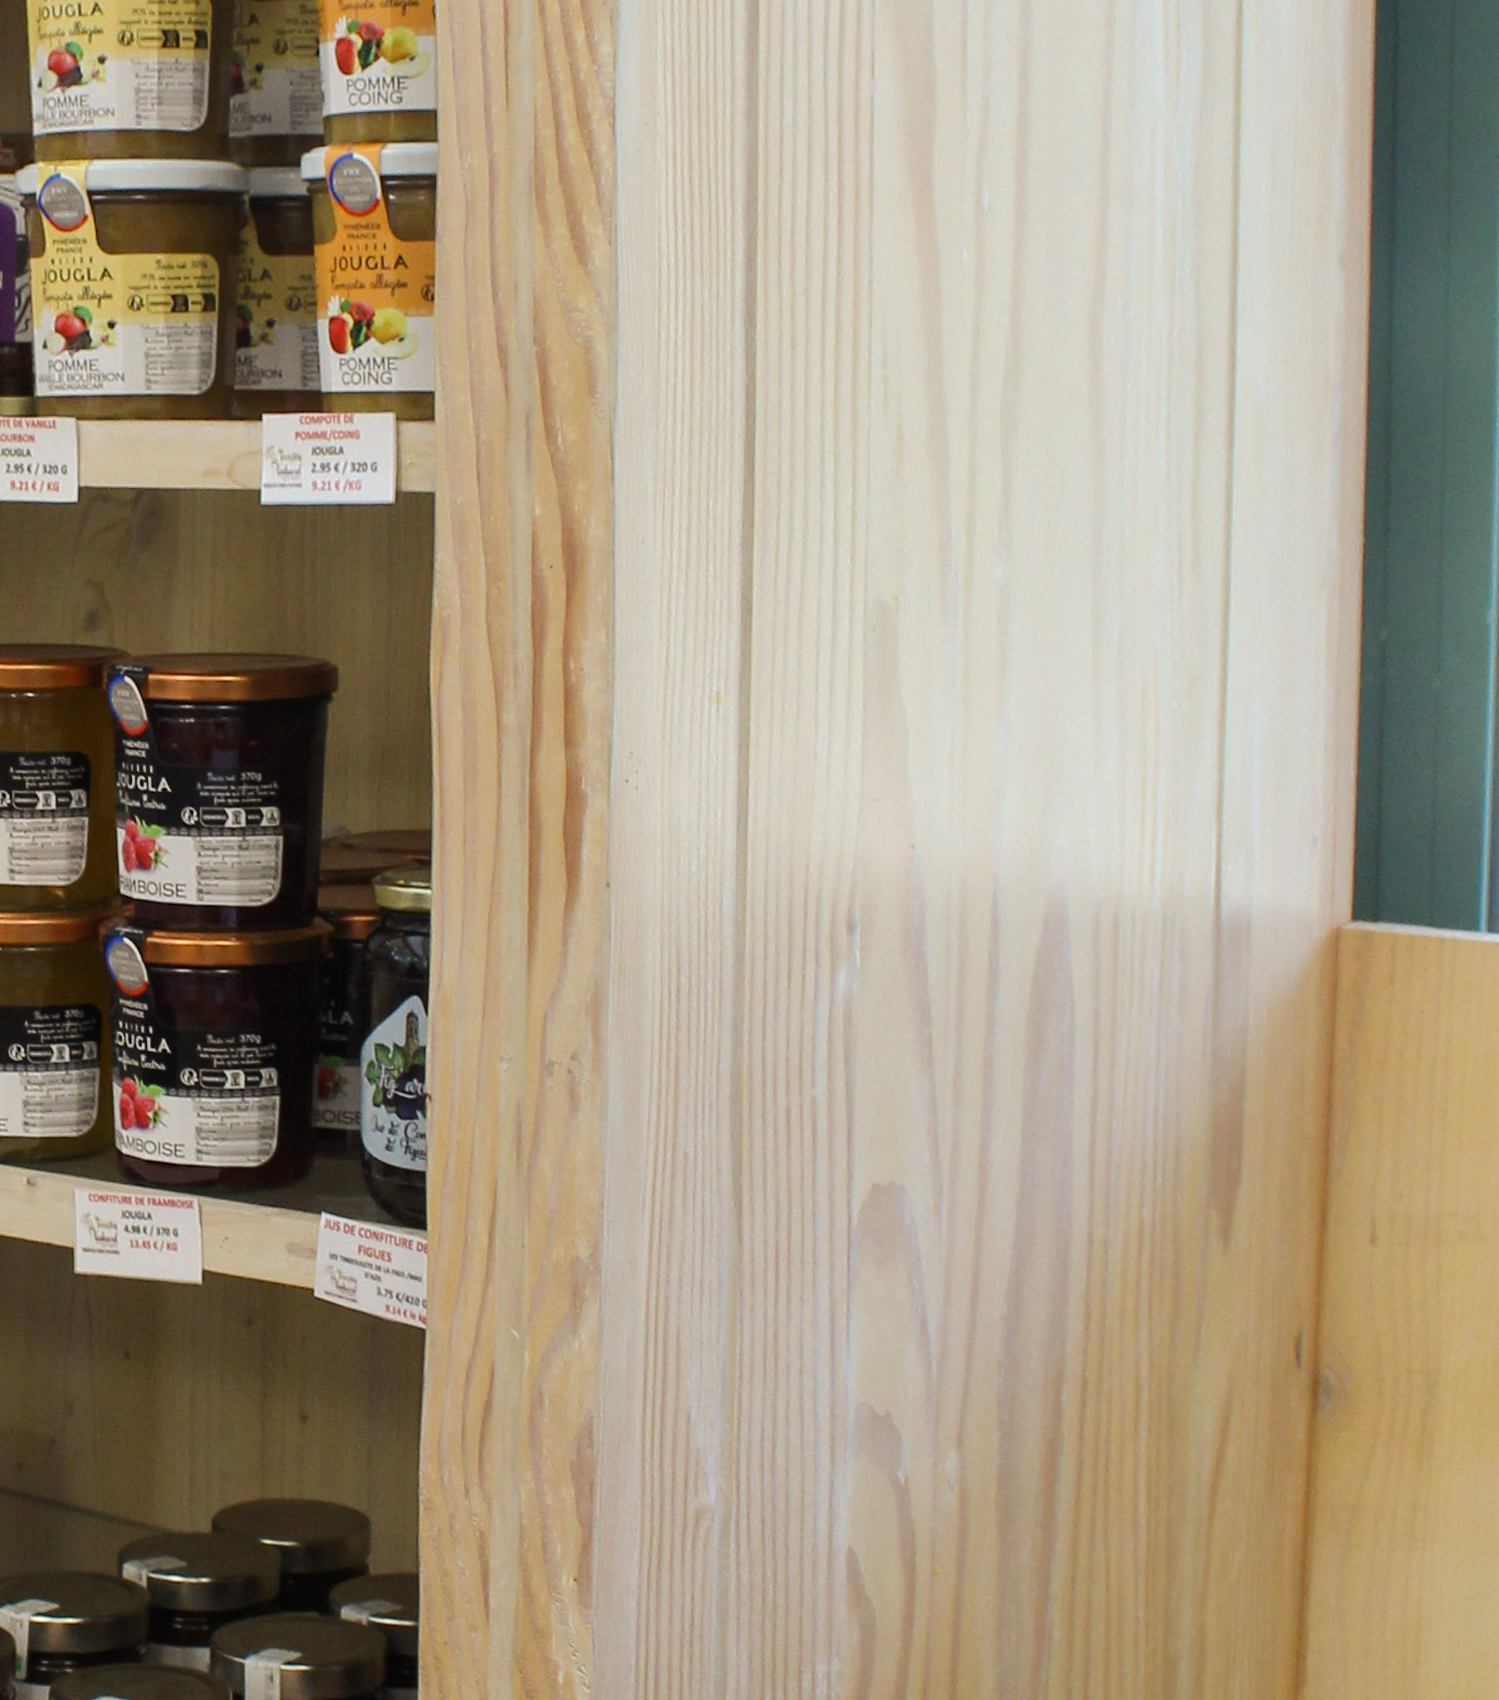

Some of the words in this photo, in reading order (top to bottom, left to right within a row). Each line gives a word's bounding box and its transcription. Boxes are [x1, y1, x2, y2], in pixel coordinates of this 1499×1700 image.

[36, 1, 104, 23] JOUGLA
[346, 76, 408, 93] POMME
[43, 94, 89, 109] POMME
[348, 92, 403, 107] COING
[330, 255, 409, 273] JOUGLA
[42, 268, 113, 285] JOUGLA
[48, 358, 99, 372] POMME
[339, 357, 398, 372] POMME
[341, 371, 392, 385] COING
[13, 419, 22, 428] DE
[25, 419, 56, 428] VANILLE
[299, 414, 341, 425] COMPOTE
[344, 414, 354, 424] DE
[295, 430, 360, 441] POMME/COING
[1, 448, 31, 457] JOUGLA
[311, 447, 344, 455] JOUGLA
[6, 464, 24, 474] 2.95
[27, 465, 32, 474] €
[42, 465, 58, 474] 320
[61, 465, 67, 474] G
[311, 462, 331, 473] 2.95
[334, 463, 340, 473] €
[350, 462, 368, 473] 320
[370, 462, 378, 472] G
[10, 480, 29, 491] 9.21
[47, 481, 59, 492] KG
[312, 480, 332, 491] 9.21
[115, 1031, 172, 1054] OUGLA
[88, 1192, 131, 1206] CONFITURE
[133, 1195, 145, 1205] DE
[148, 1196, 194, 1210] FRAMBOISE
[121, 1209, 153, 1220] JOUGLA
[324, 1218, 340, 1232] JUS
[343, 1223, 355, 1235] DE
[358, 1228, 413, 1250] CONFITURE
[357, 1245, 392, 1262] FIGUES
